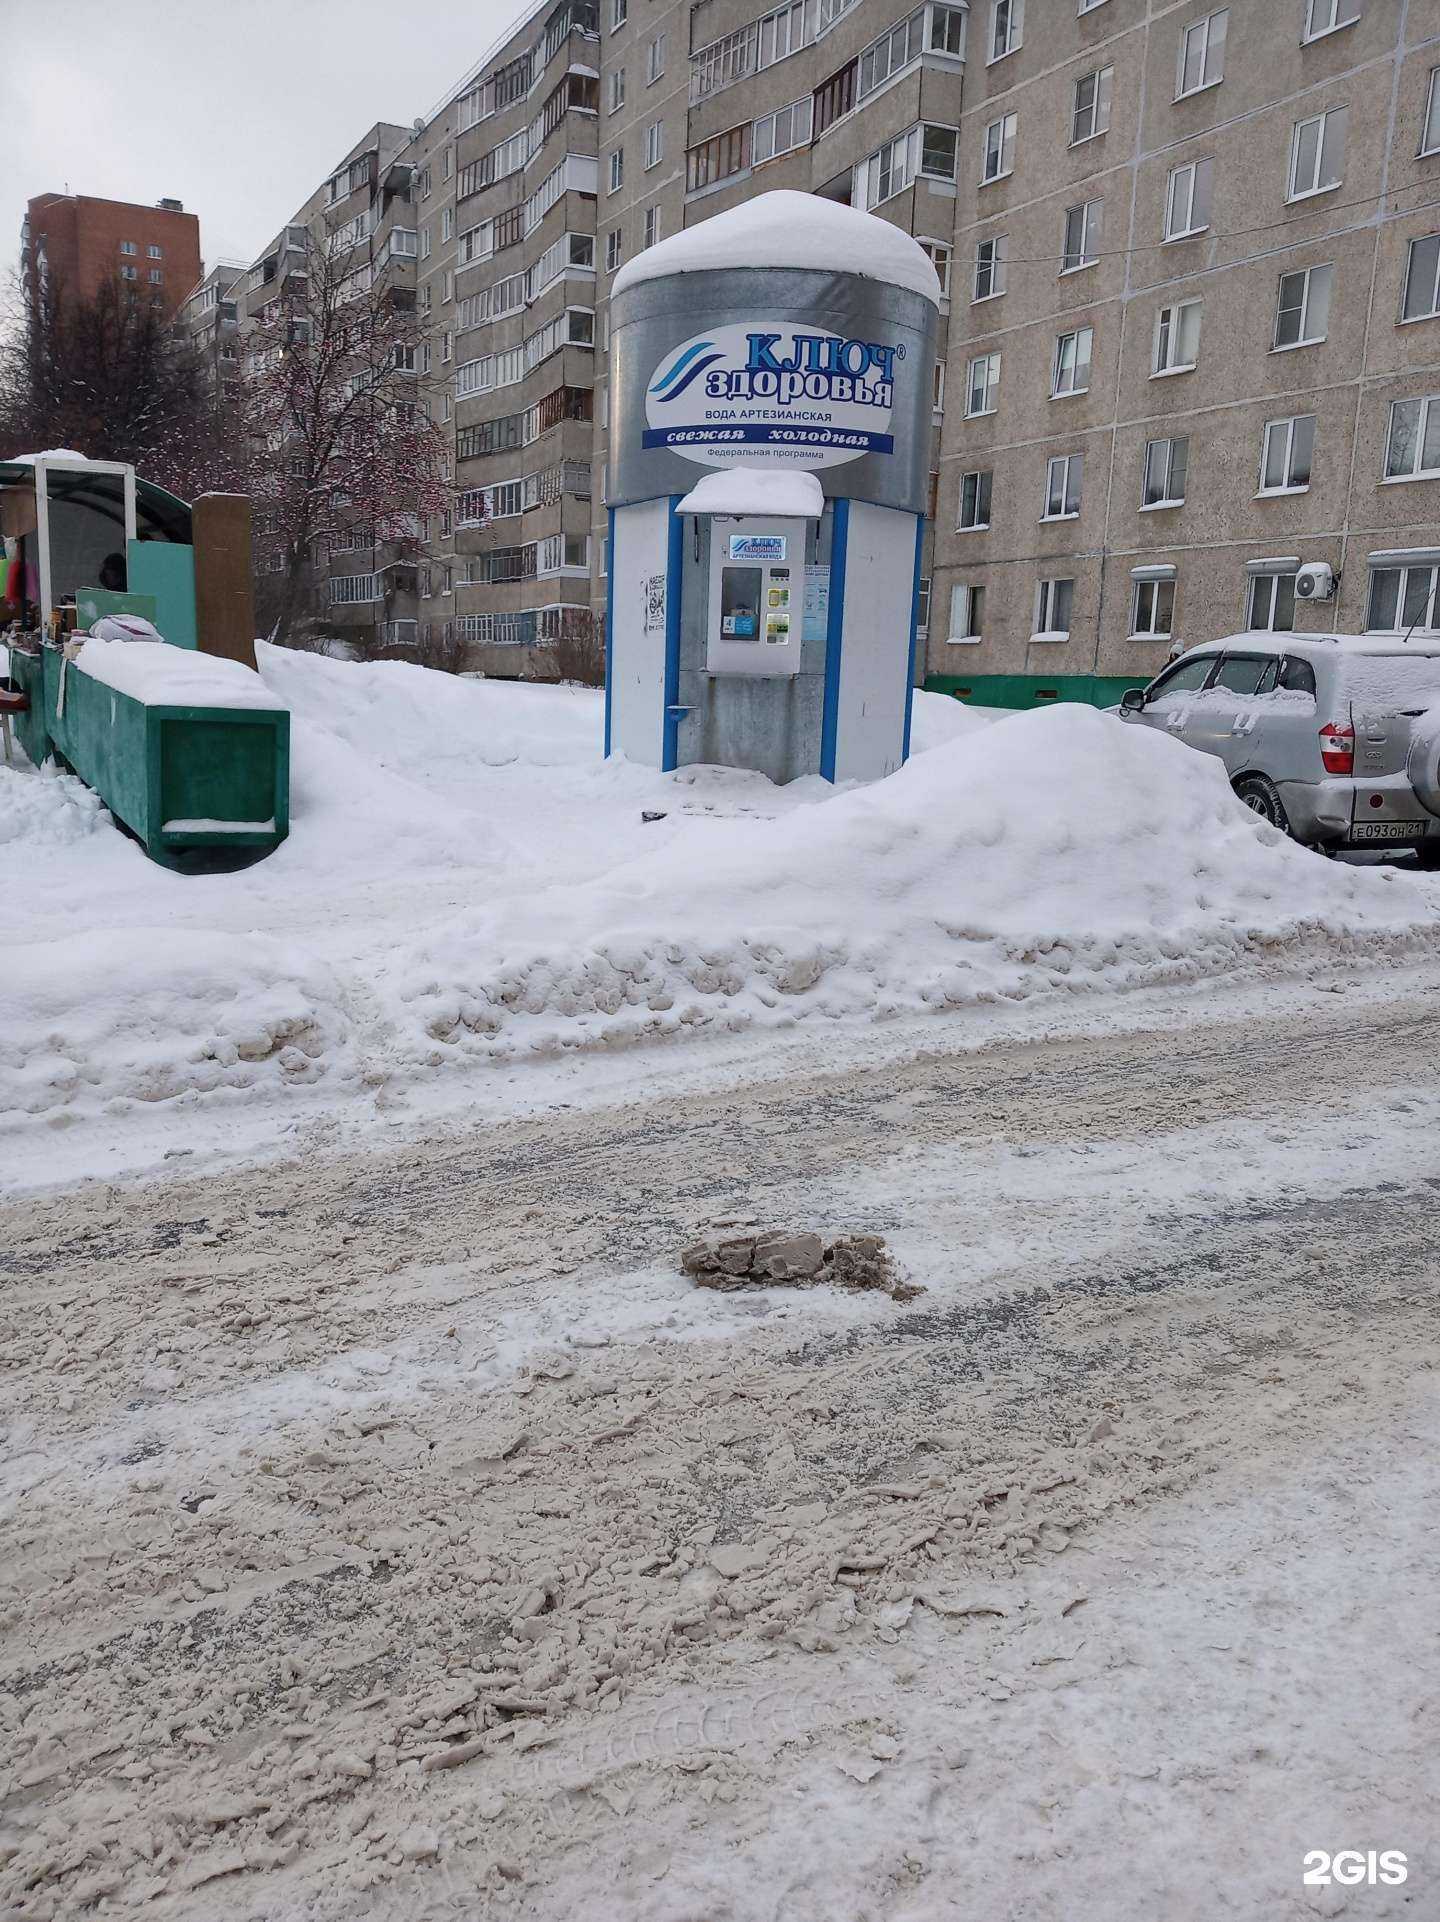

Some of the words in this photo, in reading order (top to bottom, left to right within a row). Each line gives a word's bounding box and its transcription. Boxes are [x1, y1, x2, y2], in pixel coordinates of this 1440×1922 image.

[705, 370, 893, 409] здоровья
[705, 410, 737, 420] ВОДА
[739, 409, 832, 422] АРТЕЗИАНСКАЯ
[667, 429, 746, 442] свежая
[768, 429, 870, 446] холодная
[707, 448, 771, 458] Федеральная
[773, 448, 824, 459] программа
[1408, 823, 1420, 834] 21
